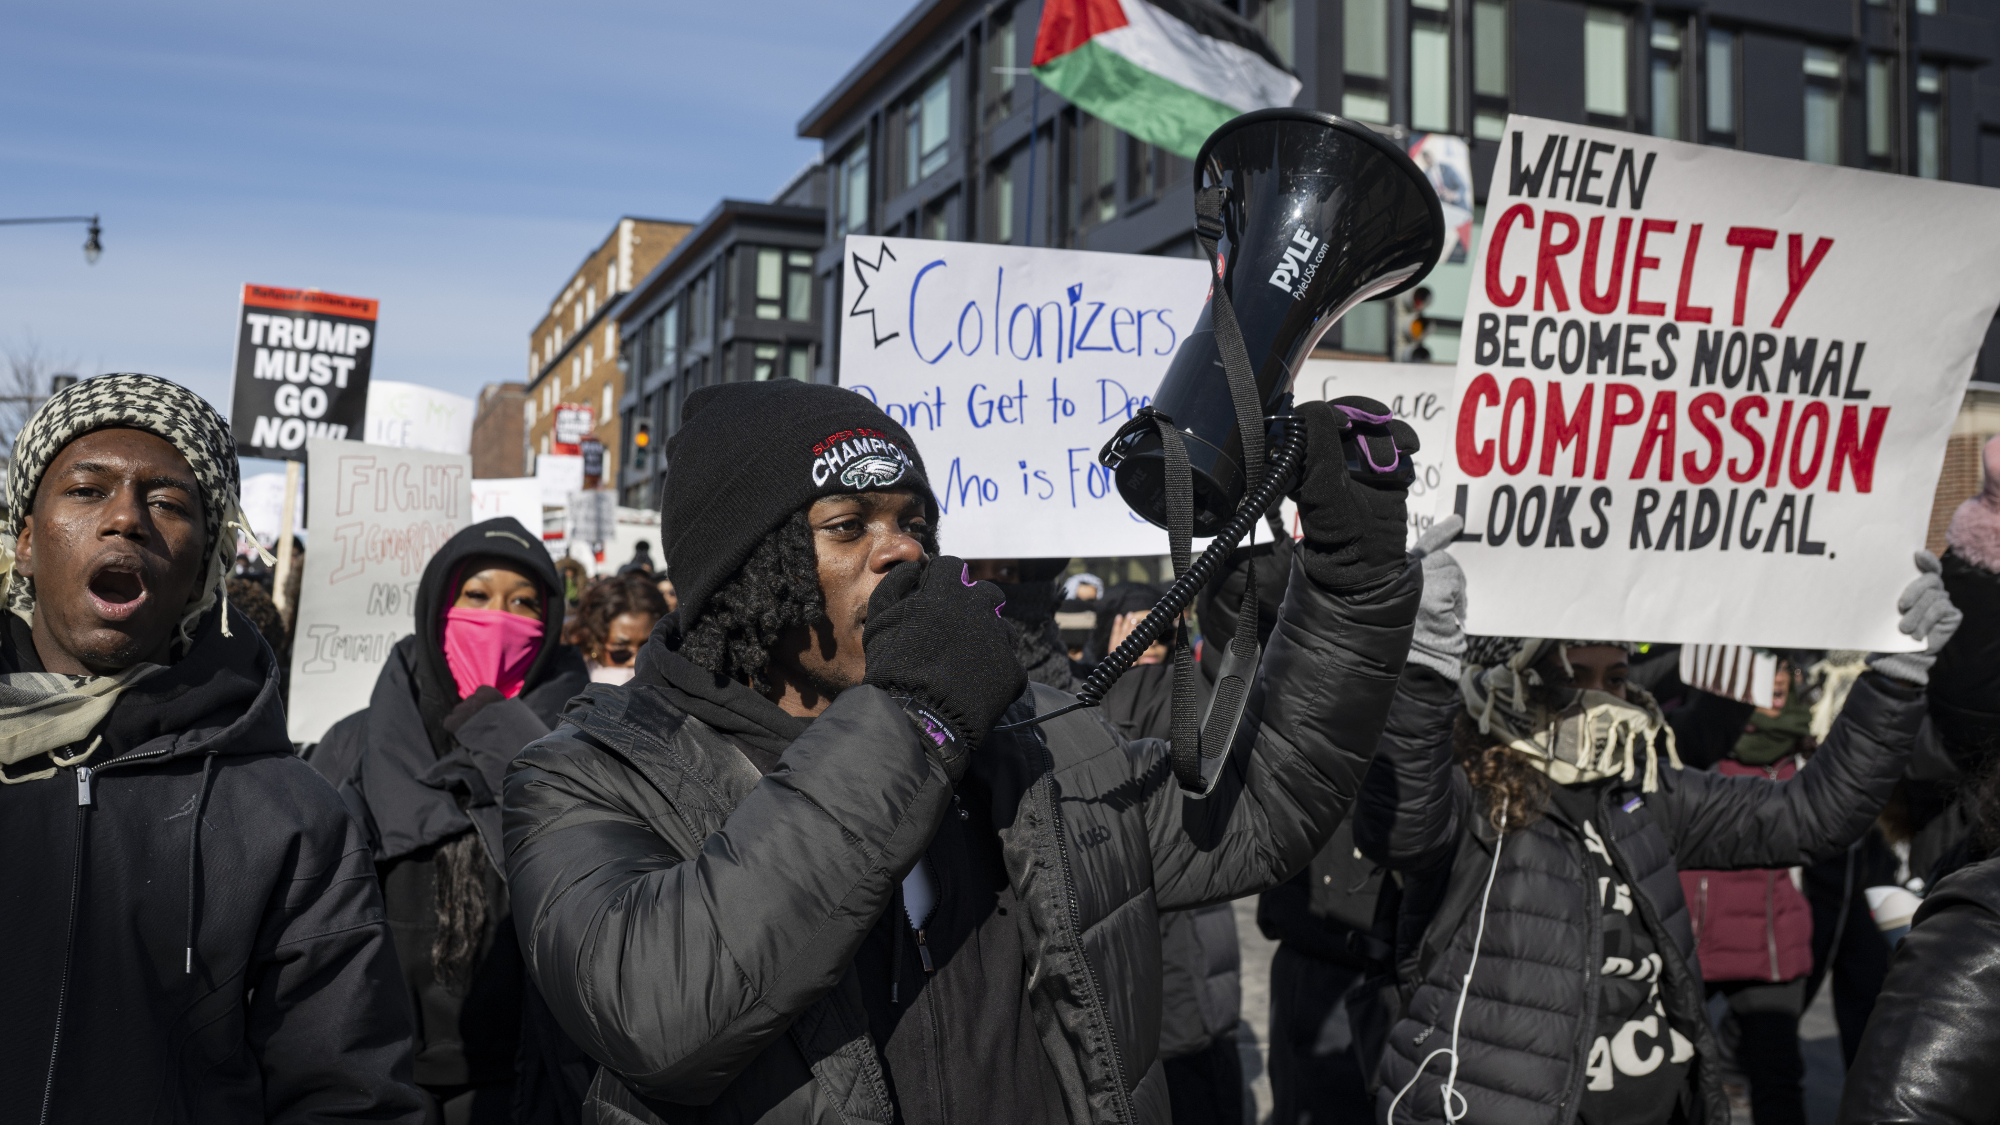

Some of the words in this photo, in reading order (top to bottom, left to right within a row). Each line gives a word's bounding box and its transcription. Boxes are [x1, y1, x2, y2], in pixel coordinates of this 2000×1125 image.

[1509, 131, 1657, 210] WHEN
[1269, 227, 1319, 293] PYLE
[1292, 242, 1330, 301] PyleUSA.com
[1485, 203, 1835, 328] CRUELTY
[246, 312, 371, 356] TRUMP
[909, 259, 1176, 364] Colonizers
[253, 348, 355, 388] MUST
[1475, 312, 1680, 381] BECOMES
[1690, 330, 1870, 399] NORMAL
[274, 384, 329, 419] GO
[967, 379, 1028, 428] Get
[1047, 378, 1075, 424] to
[1455, 373, 1891, 493] COMPASSION
[812, 430, 854, 455] SUPER
[335, 455, 463, 519] FIGHT
[1018, 460, 1054, 500] is
[330, 520, 456, 585] IGNORAN
[1454, 483, 1612, 550] LOOKS
[1630, 487, 1837, 560] RADICAL.
[366, 581, 420, 617] NOT
